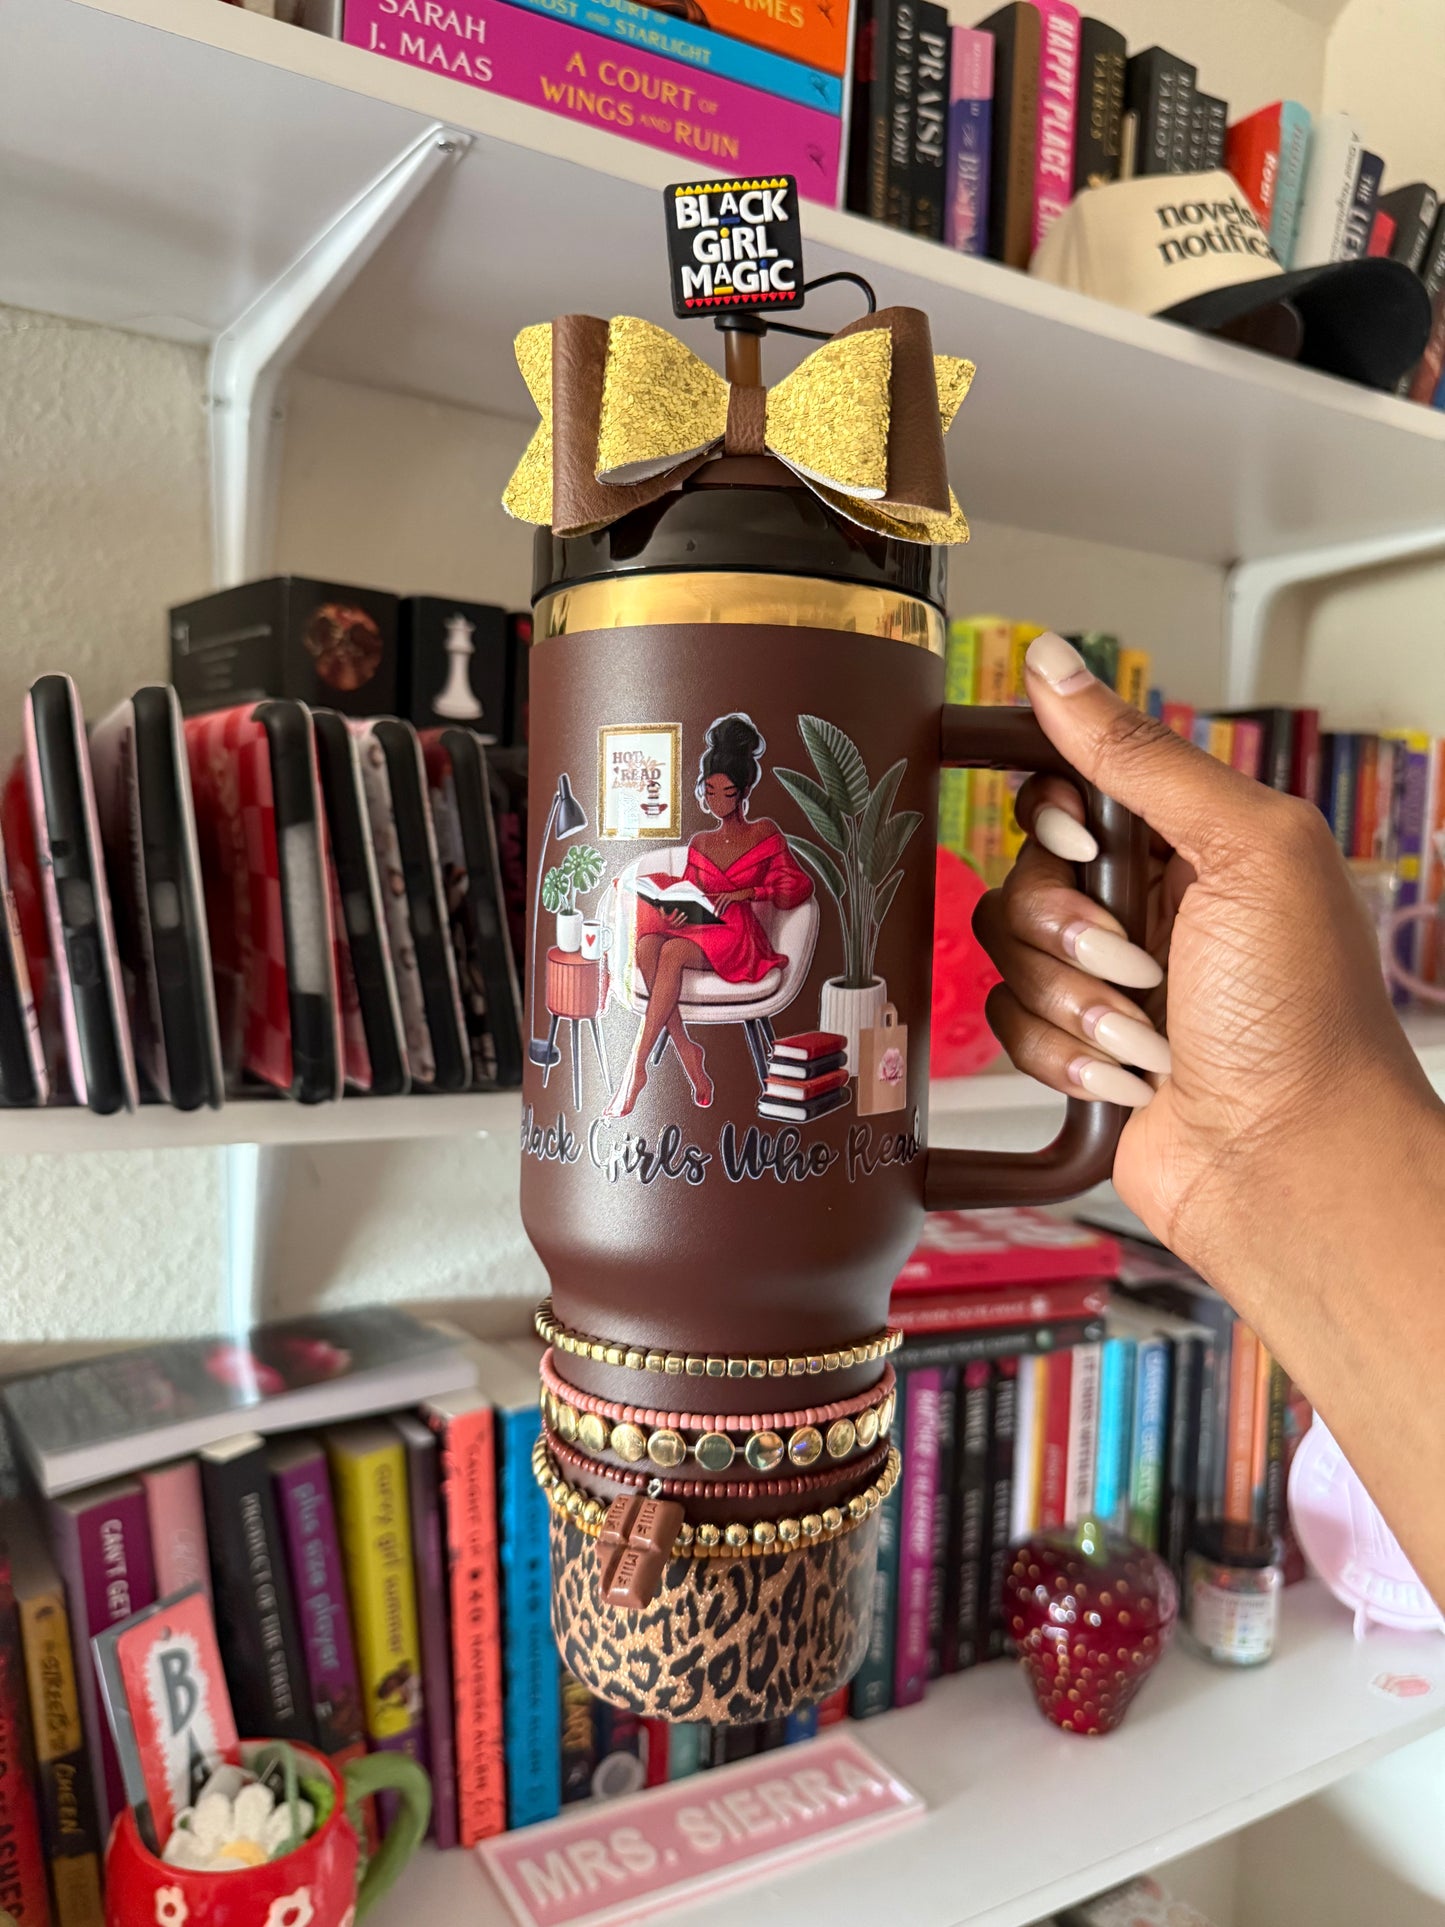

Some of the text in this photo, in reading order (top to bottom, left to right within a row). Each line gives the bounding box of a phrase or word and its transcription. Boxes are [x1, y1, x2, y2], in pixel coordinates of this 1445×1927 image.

[379, 0, 486, 44] SARAH
[400, 32, 493, 82] MAAS
[614, 19, 712, 65] STARLIGHT
[1044, 14, 1076, 99] HAPPY
[539, 75, 740, 160] WINGS AND RUIN
[565, 51, 719, 115] A COURT OF
[915, 30, 946, 168] PRAISE
[1154, 71, 1175, 159] YARROS
[1038, 98, 1070, 183] PLACE
[675, 189, 789, 230] BLACK
[1156, 197, 1259, 230] novels
[1356, 173, 1376, 204] THE
[612, 750, 644, 764] HOT
[621, 768, 661, 781] READ
[589, 1116, 713, 1186] Girls
[719, 1120, 839, 1184] Who
[847, 1105, 921, 1184] Read
[100, 1518, 133, 1622] CAN'T GET
[240, 1492, 273, 1584] PRODUCT
[290, 1481, 341, 1672] plus size player
[376, 1534, 405, 1569] girl
[384, 1576, 406, 1657] summer
[516, 1756, 885, 1910] MRS. SIERRA
